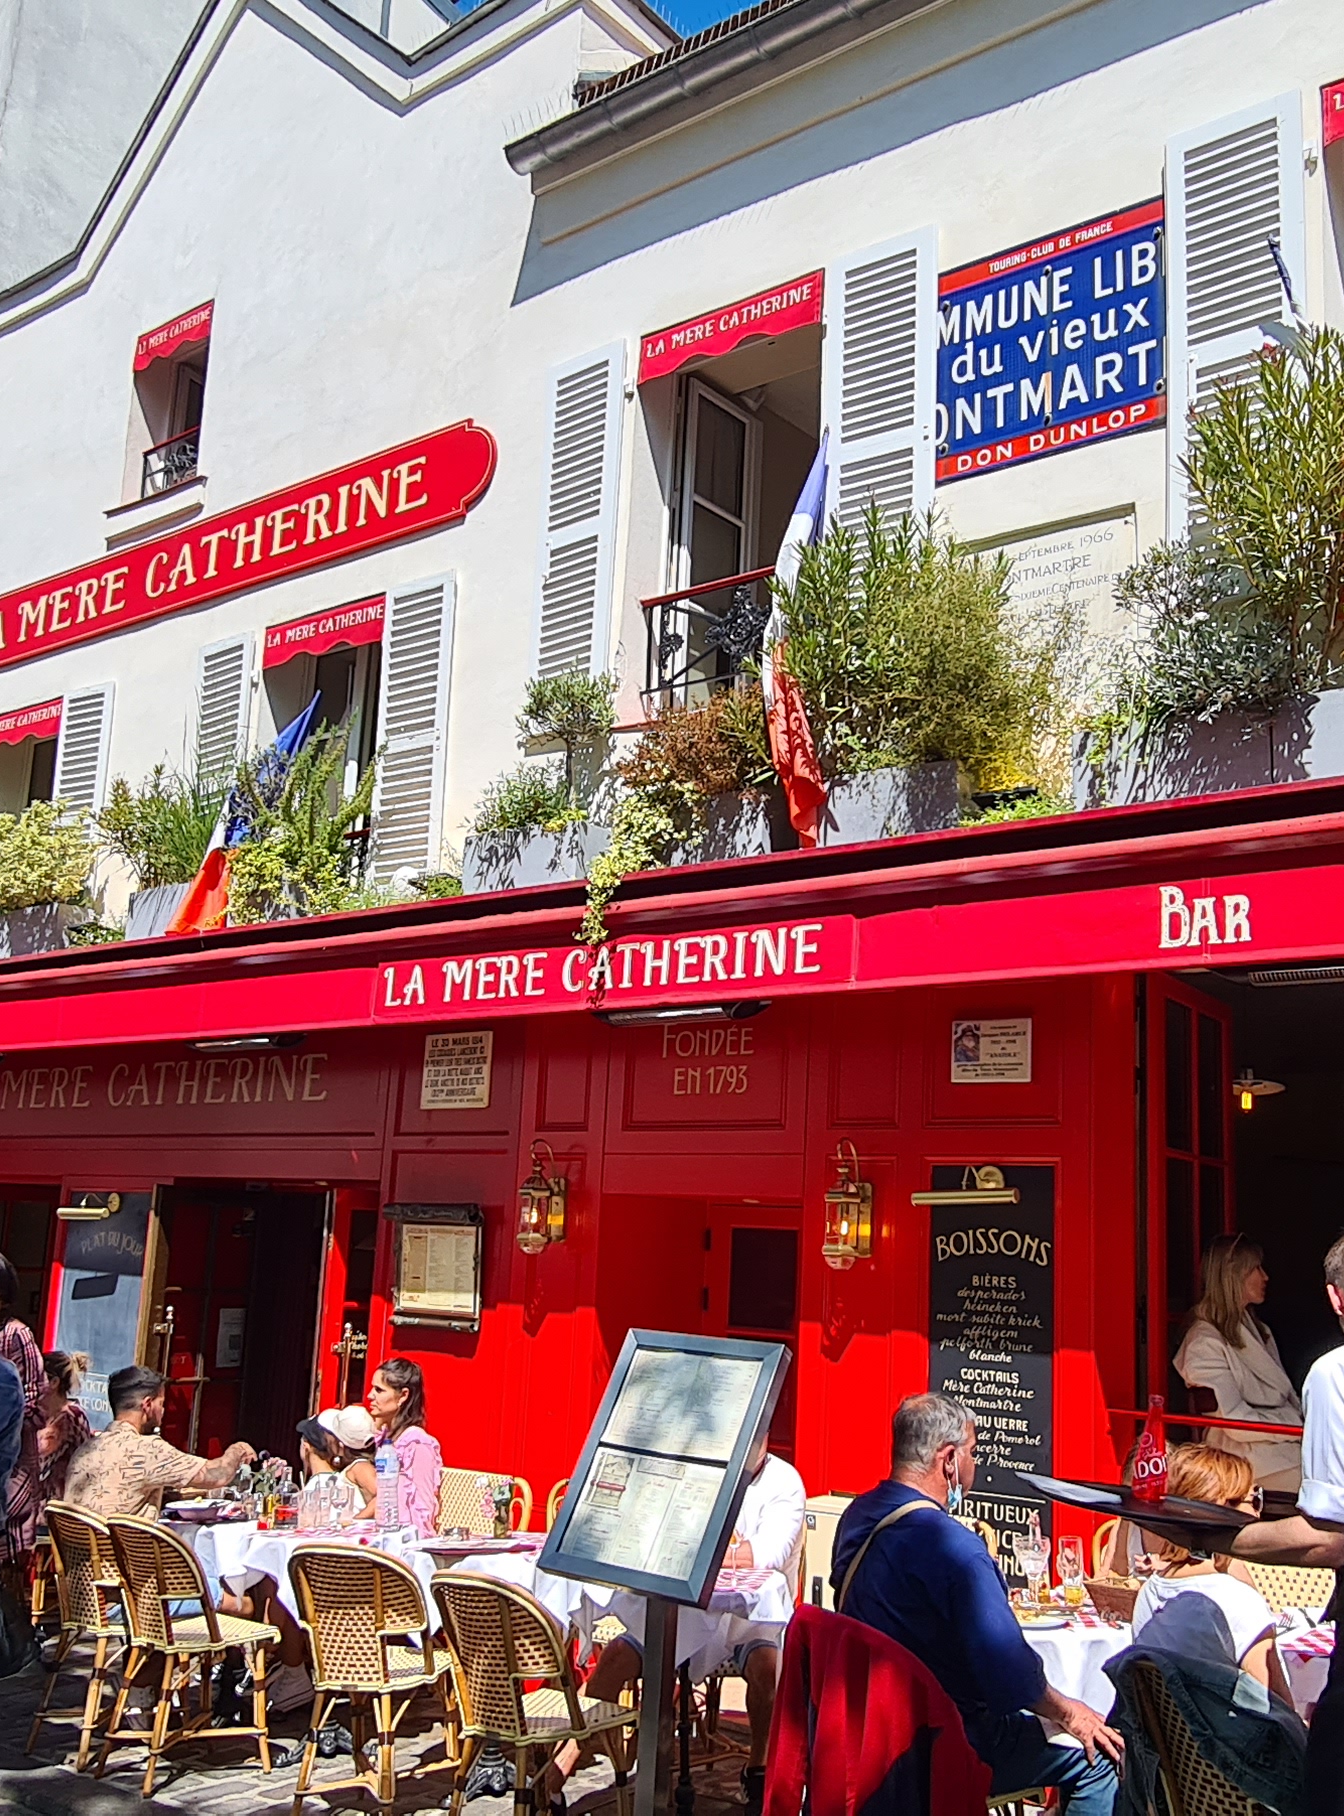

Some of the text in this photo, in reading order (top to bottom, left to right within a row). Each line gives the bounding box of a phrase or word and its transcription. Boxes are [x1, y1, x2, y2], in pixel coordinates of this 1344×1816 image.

[1058, 232, 1072, 249] DE
[1075, 221, 1113, 243] FRANCE
[1093, 234, 1165, 299] LIB
[646, 282, 813, 358] LA MERE CATHERINE
[951, 297, 1149, 384] du vieux
[935, 337, 1166, 447] ONTMART
[957, 404, 1147, 472] DON DUNLOP
[17, 566, 129, 643] MERE
[144, 456, 428, 598] CATHERINE
[1012, 527, 1114, 562] EPTEMBRE 1966
[267, 603, 385, 648] LA MERE CATHERINE
[1158, 886, 1252, 949] BAR
[384, 923, 823, 1007] LA MERE CATHERINE
[662, 1024, 754, 1058] FONDÉE
[1, 1066, 93, 1110] MERE
[107, 1053, 328, 1107] CATHERINE
[673, 1065, 748, 1095] EN 1793
[935, 1228, 1052, 1267] BOISSONS
[957, 1287, 1026, 1302] desperados
[972, 1272, 1017, 1288] BIÈRES
[936, 1312, 968, 1323] mort
[1008, 1314, 1044, 1329] kriek
[963, 1299, 1018, 1314] heineken
[939, 1336, 1033, 1353] pelforth brune
[963, 1325, 1018, 1341] affligem
[969, 1349, 1012, 1363] blanche
[942, 1379, 1036, 1400] Mère Catherine
[960, 1368, 1020, 1385] COCKTAILS
[953, 1395, 1022, 1413] Montmartre
[976, 1415, 992, 1428] AU
[977, 1430, 1042, 1446] de Pomerol
[986, 1454, 1035, 1472] Provence
